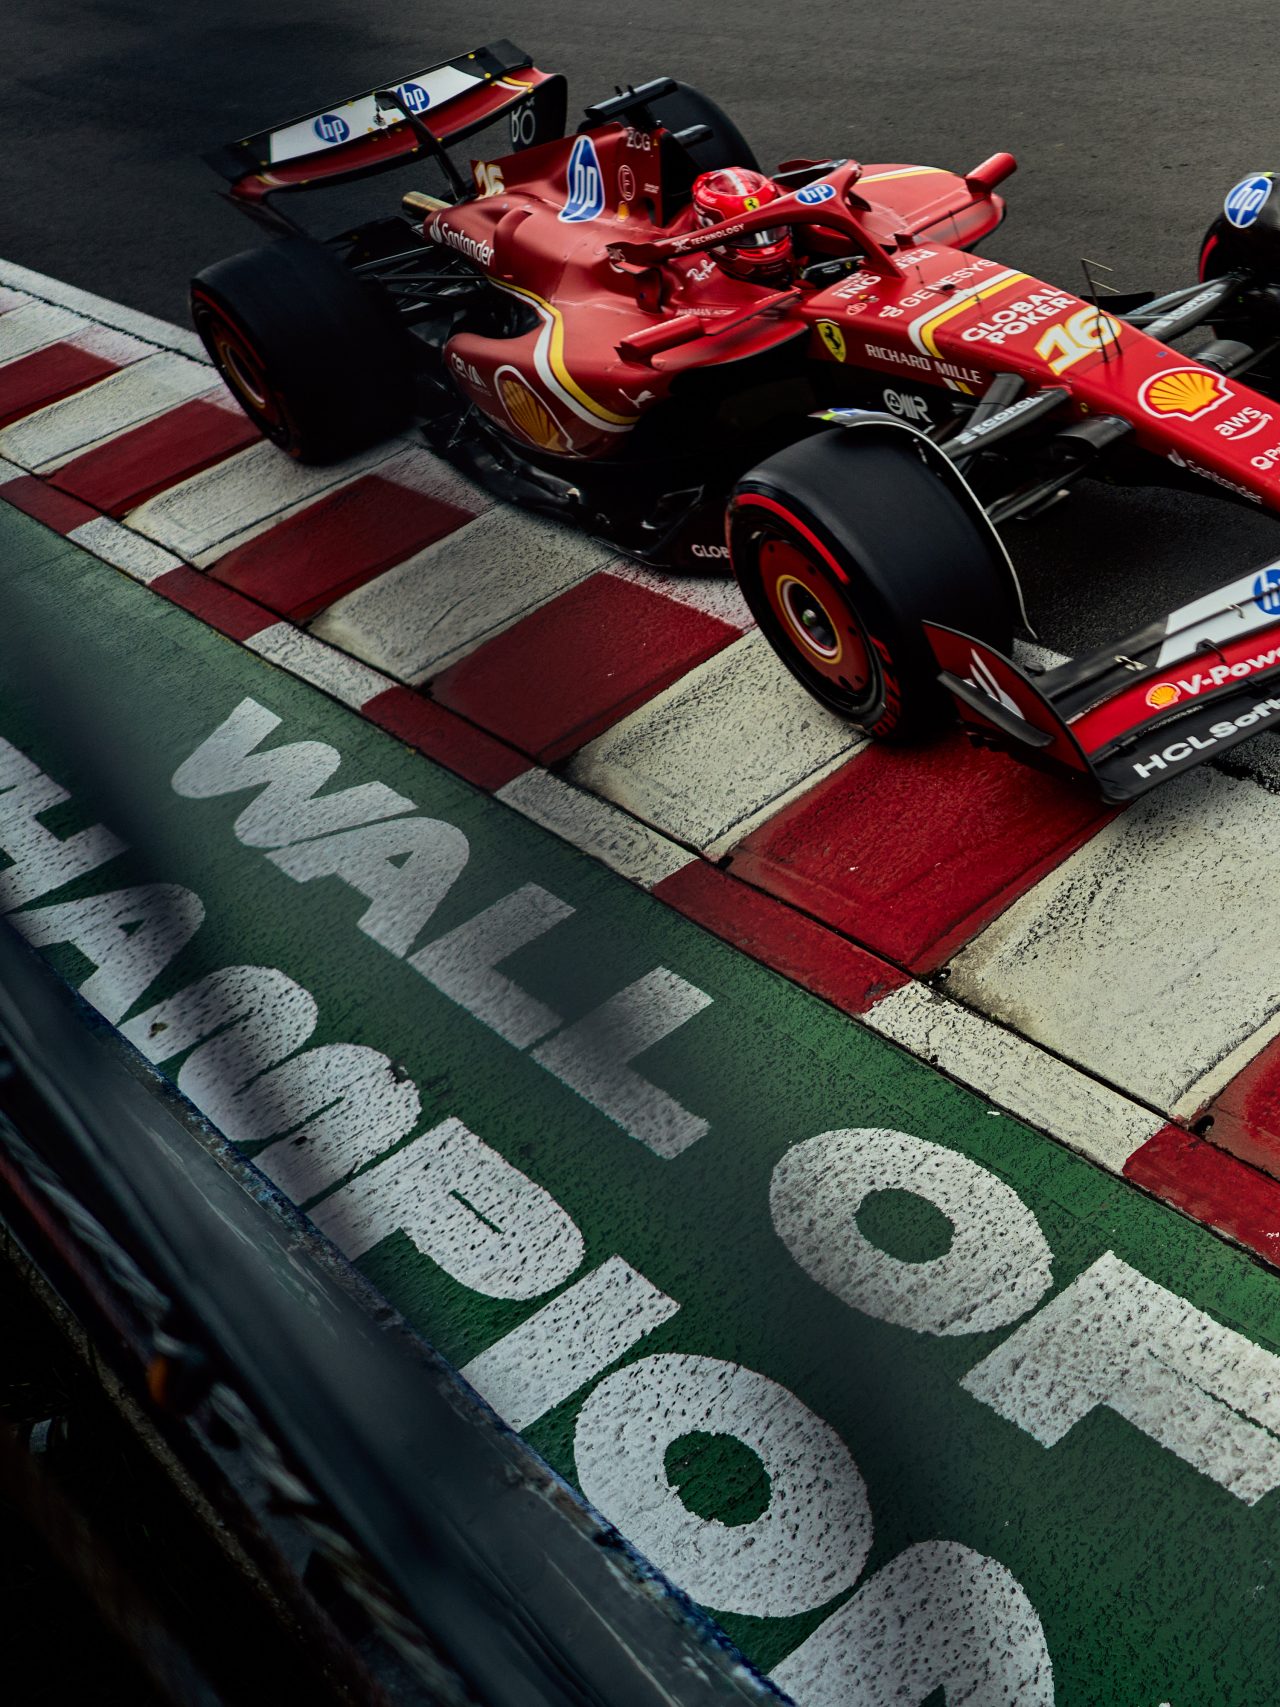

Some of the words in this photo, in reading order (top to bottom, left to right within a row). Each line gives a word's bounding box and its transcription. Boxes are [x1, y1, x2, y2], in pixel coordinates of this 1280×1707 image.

[401, 84, 426, 111] hp
[318, 114, 346, 143] hp
[570, 139, 600, 219] hp
[798, 184, 831, 205] hp
[1228, 178, 1266, 226] hp
[441, 221, 495, 266] Santander
[691, 223, 745, 245] TECHNOLOGY
[898, 259, 999, 308] GENESYS
[961, 288, 1067, 342] GLOBAL
[985, 296, 1077, 344] POKER
[864, 344, 932, 371] RICHARD
[935, 361, 984, 384] MILLE
[1034, 305, 1123, 376] 16
[1213, 406, 1263, 436] aws
[1186, 459, 1264, 505] Santander
[171, 696, 712, 1162] WALL
[0, 736, 1056, 1707] HAMPIO
